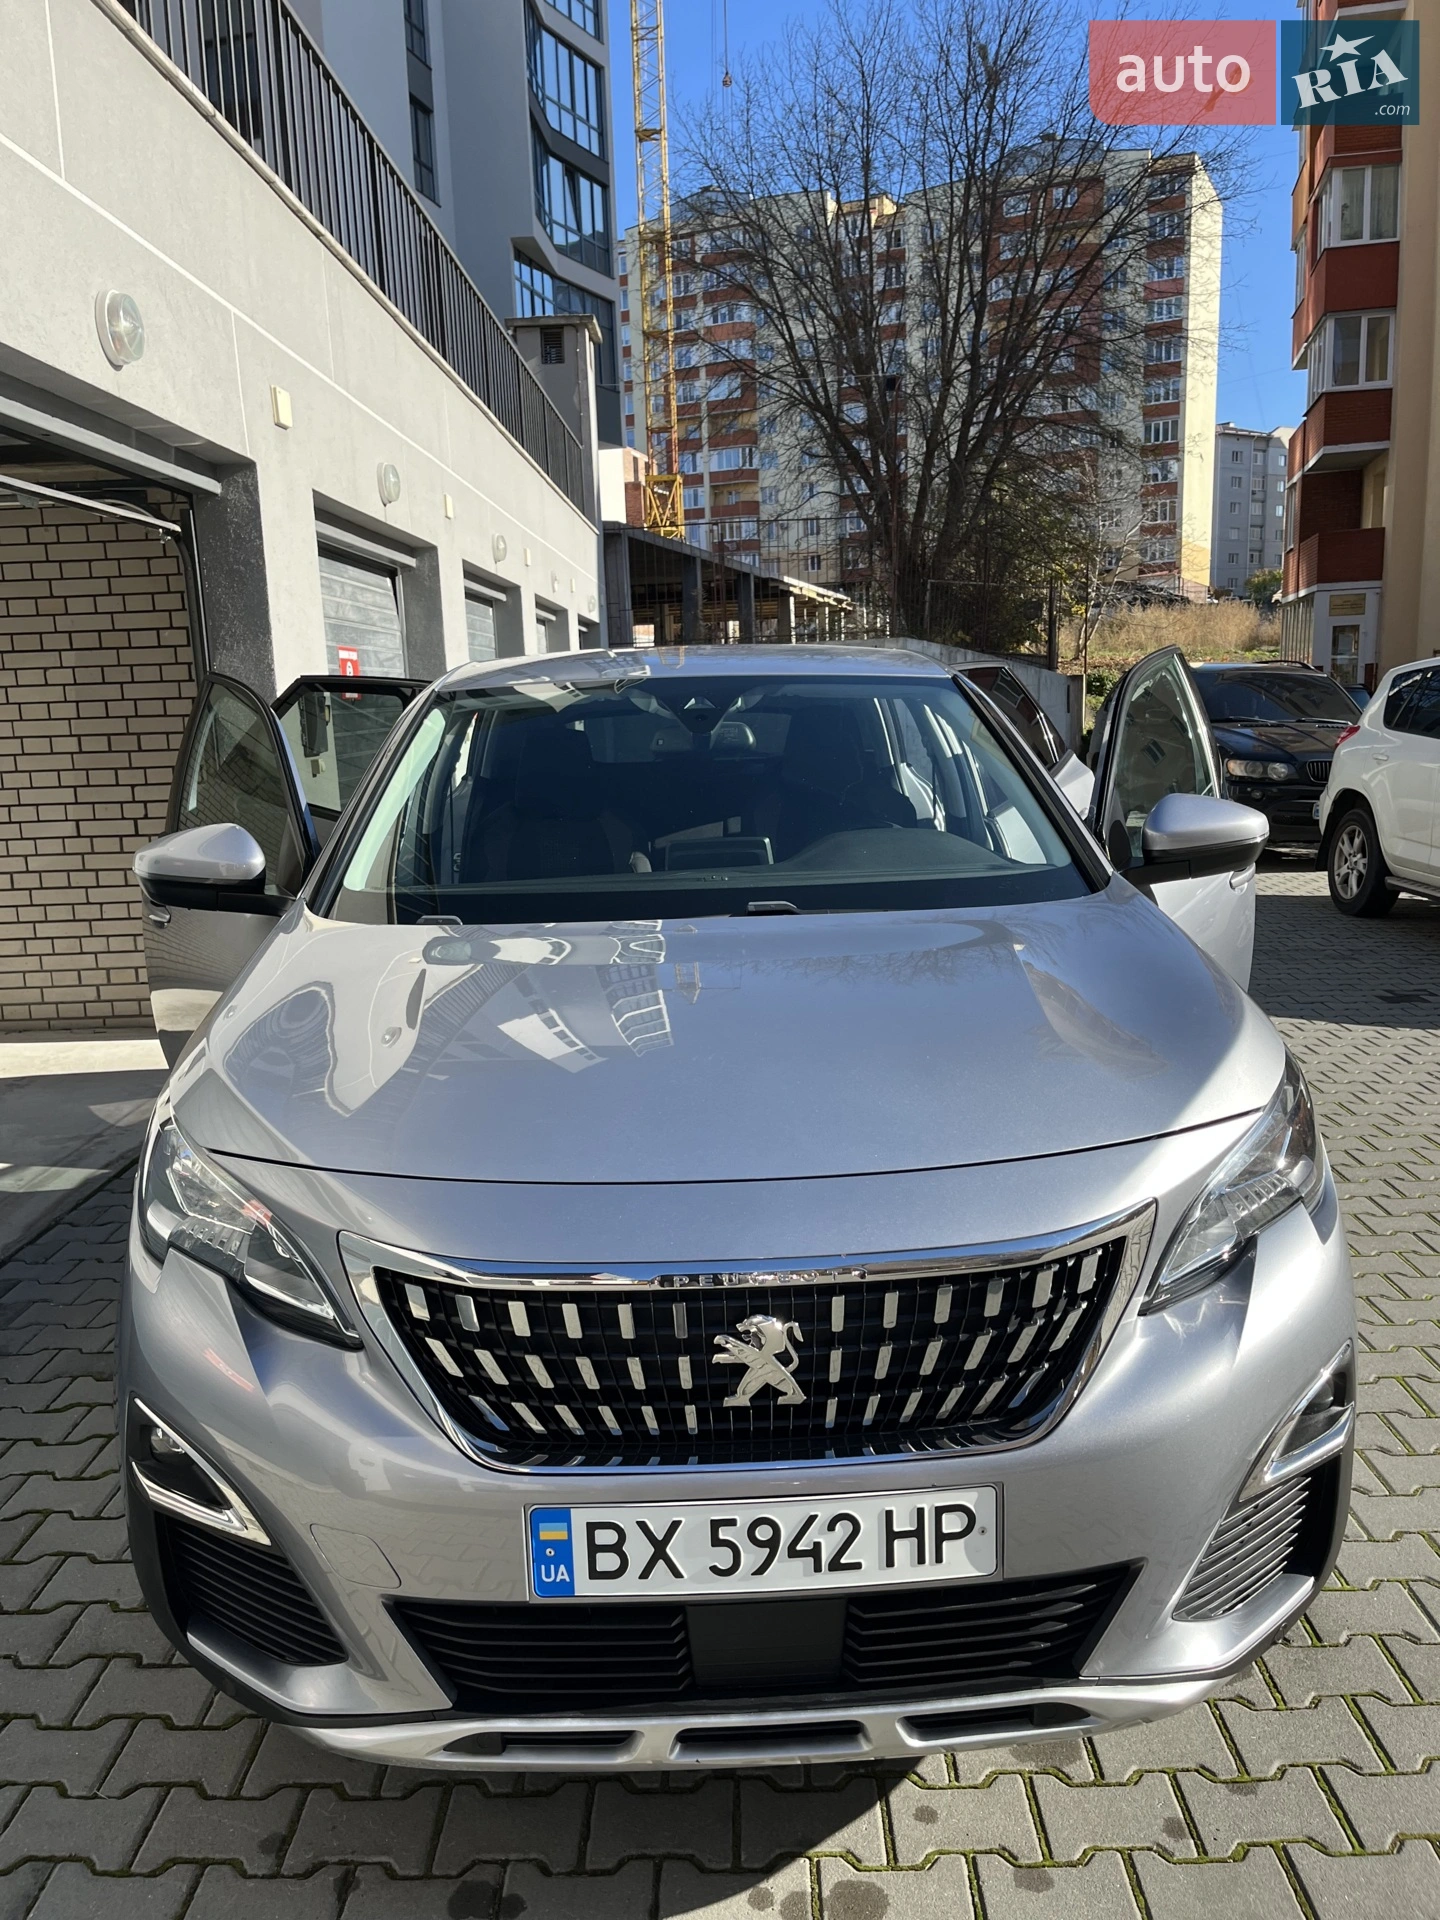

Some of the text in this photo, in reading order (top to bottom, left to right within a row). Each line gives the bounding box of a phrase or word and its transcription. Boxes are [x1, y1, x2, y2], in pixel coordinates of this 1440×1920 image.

[673, 1268, 839, 1288] PEUGEOT
[585, 1503, 977, 1580] BX 5942 HP
[541, 1564, 571, 1583] UA
